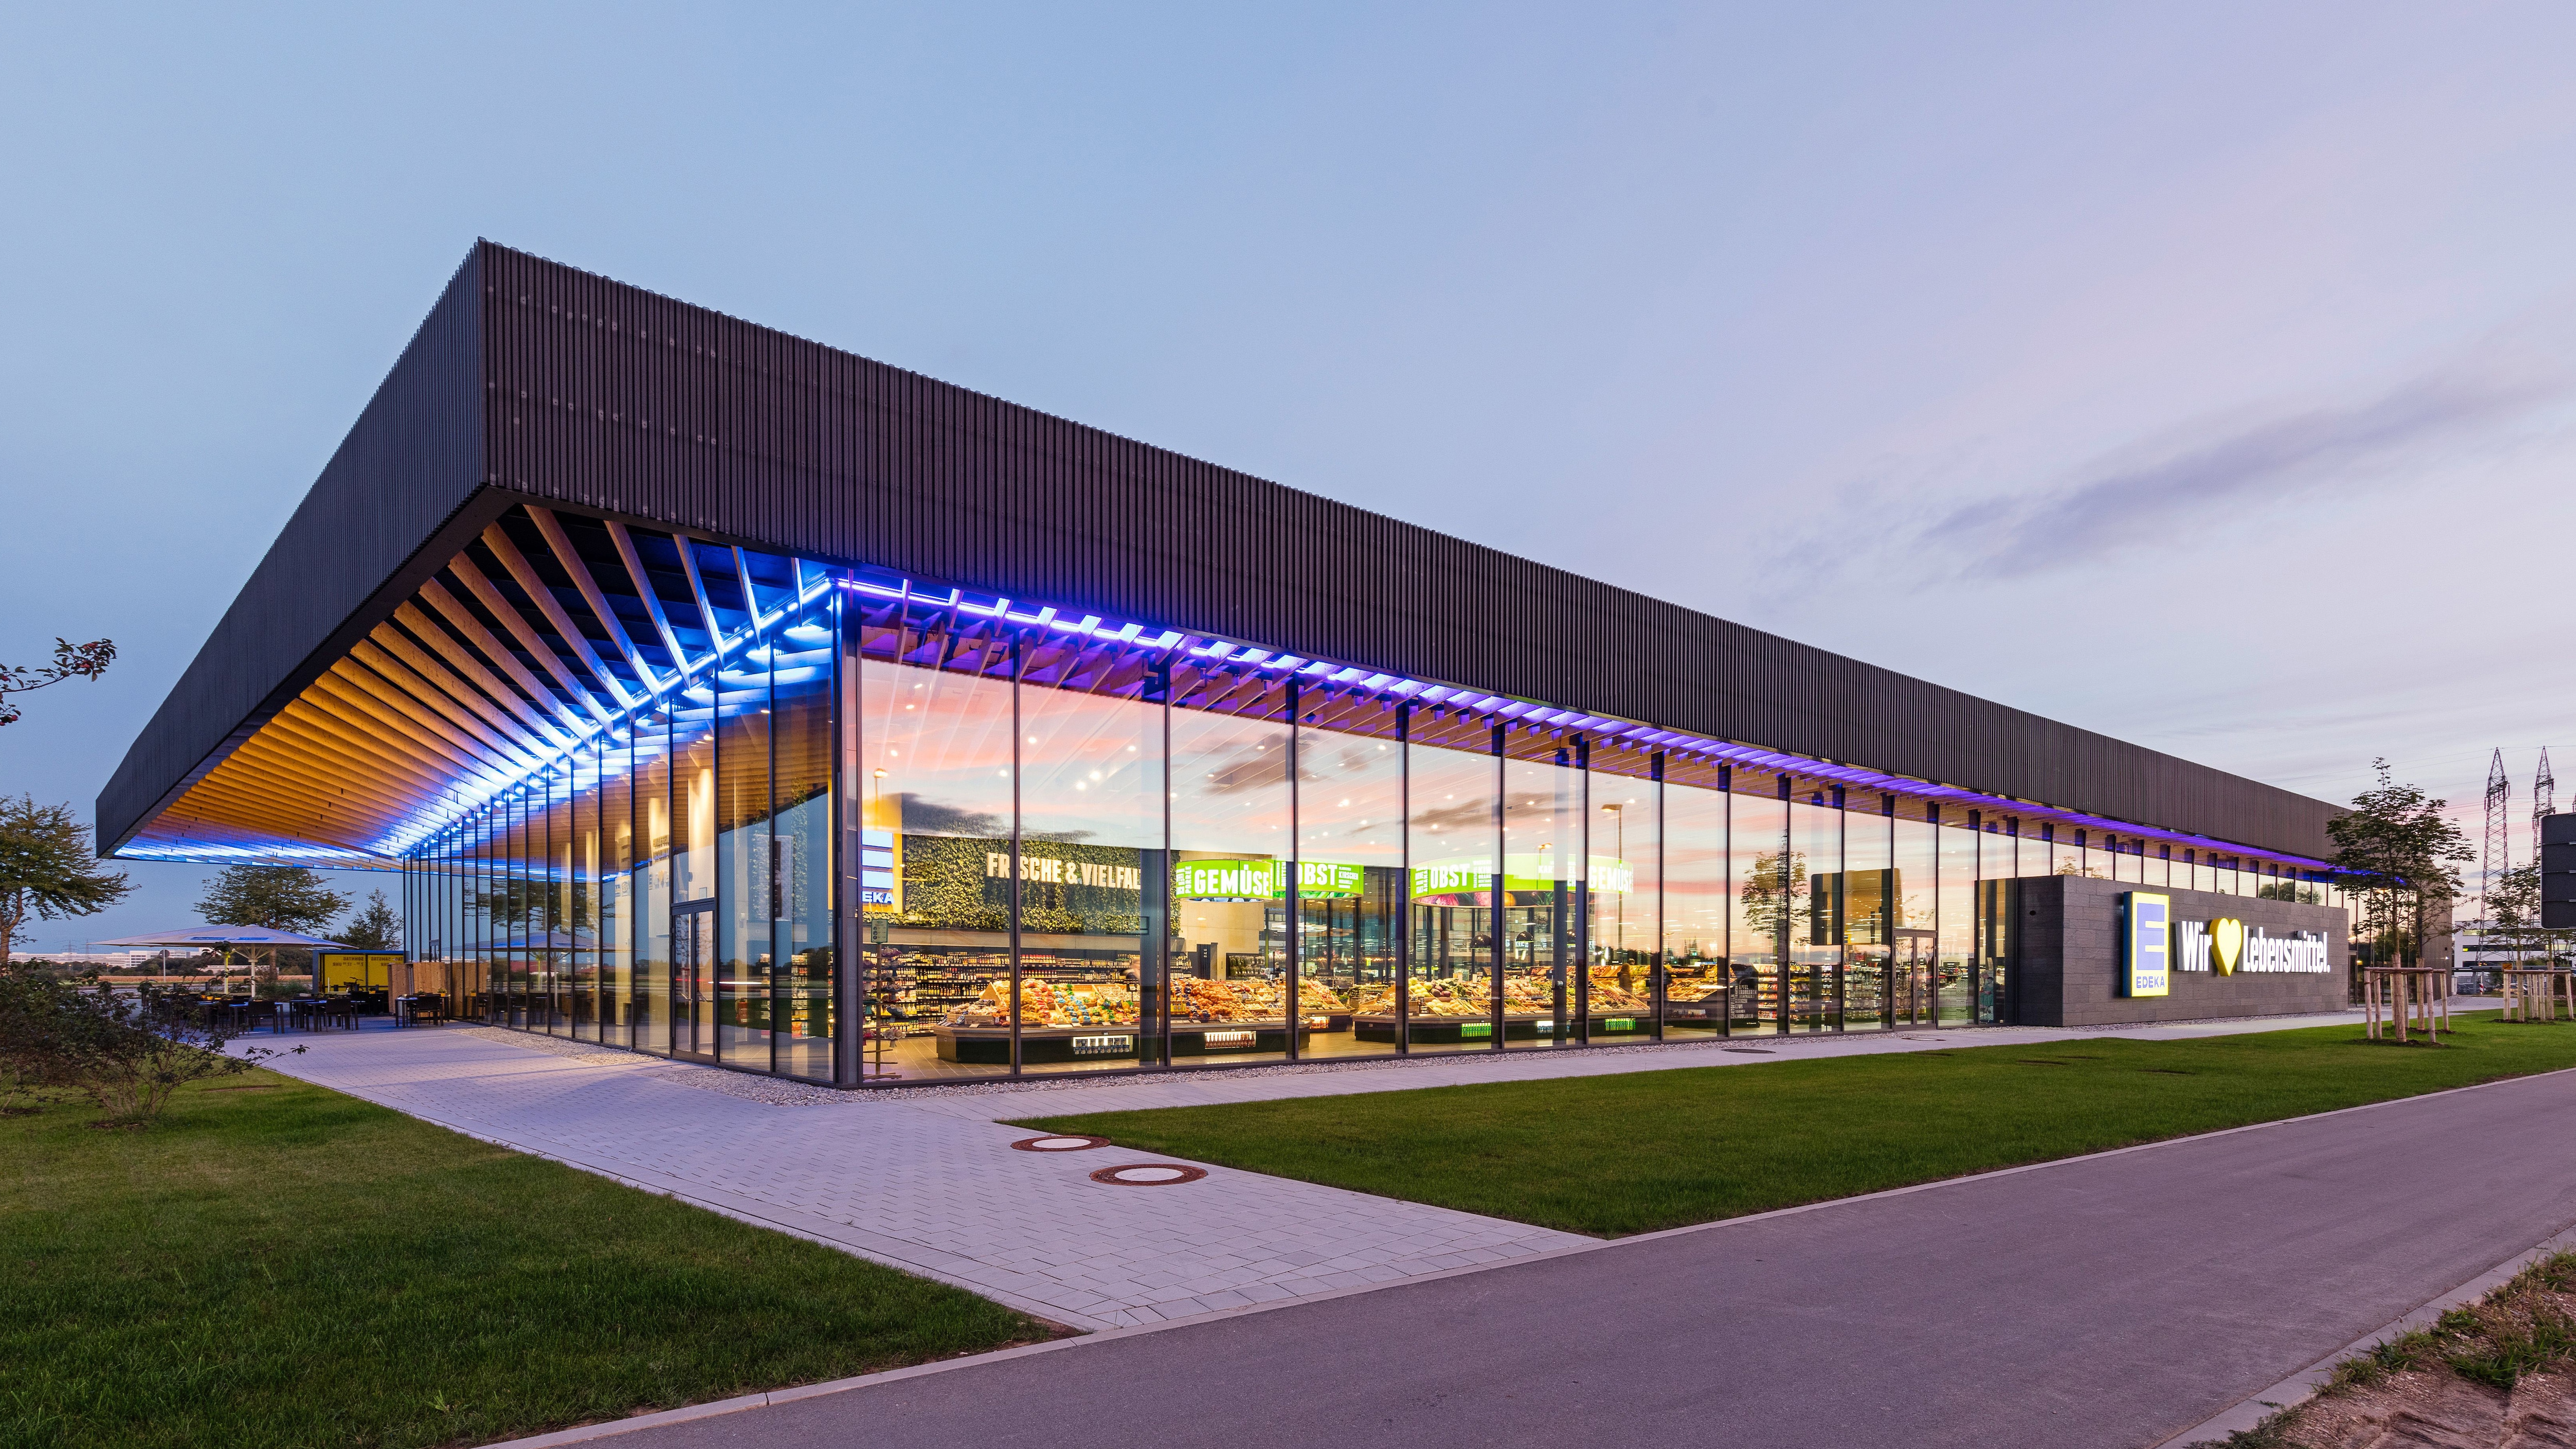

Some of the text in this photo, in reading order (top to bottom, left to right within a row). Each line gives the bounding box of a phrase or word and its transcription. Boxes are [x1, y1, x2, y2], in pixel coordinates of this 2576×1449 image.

[987, 852, 1141, 889] FRSCHE & VIELFAL
[1194, 864, 1269, 896] GEMÜSE
[1338, 871, 1359, 880] KIRSCHEN
[1430, 864, 1470, 889] OBST
[1589, 863, 1632, 893] GEMÜSE
[862, 890, 894, 903] EKA
[2181, 920, 2330, 973] Wir Lebensmittel.
[2136, 976, 2165, 988] EDEKA
